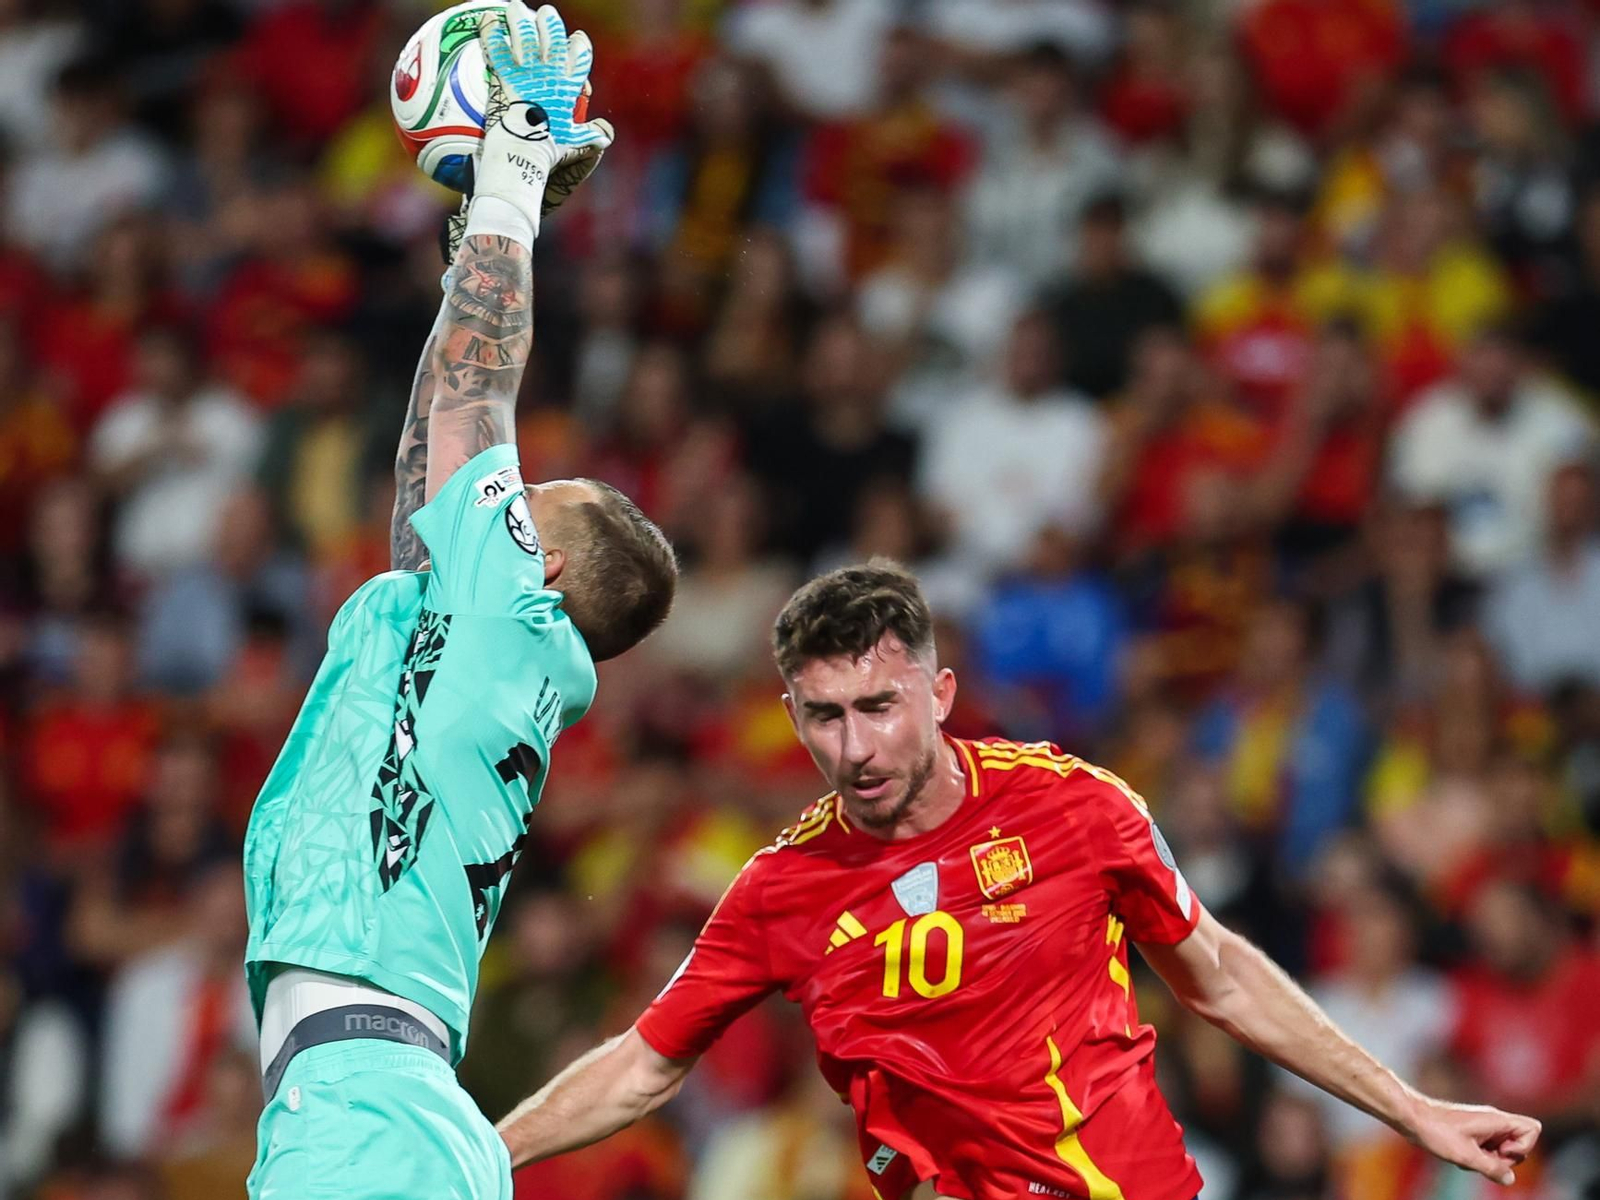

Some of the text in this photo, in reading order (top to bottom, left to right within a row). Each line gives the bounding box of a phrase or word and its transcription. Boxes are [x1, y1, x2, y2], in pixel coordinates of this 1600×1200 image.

[507, 152, 545, 187] VUTSO
[521, 171, 534, 186] 92
[873, 910, 964, 999] 10
[344, 1013, 430, 1049] macron
